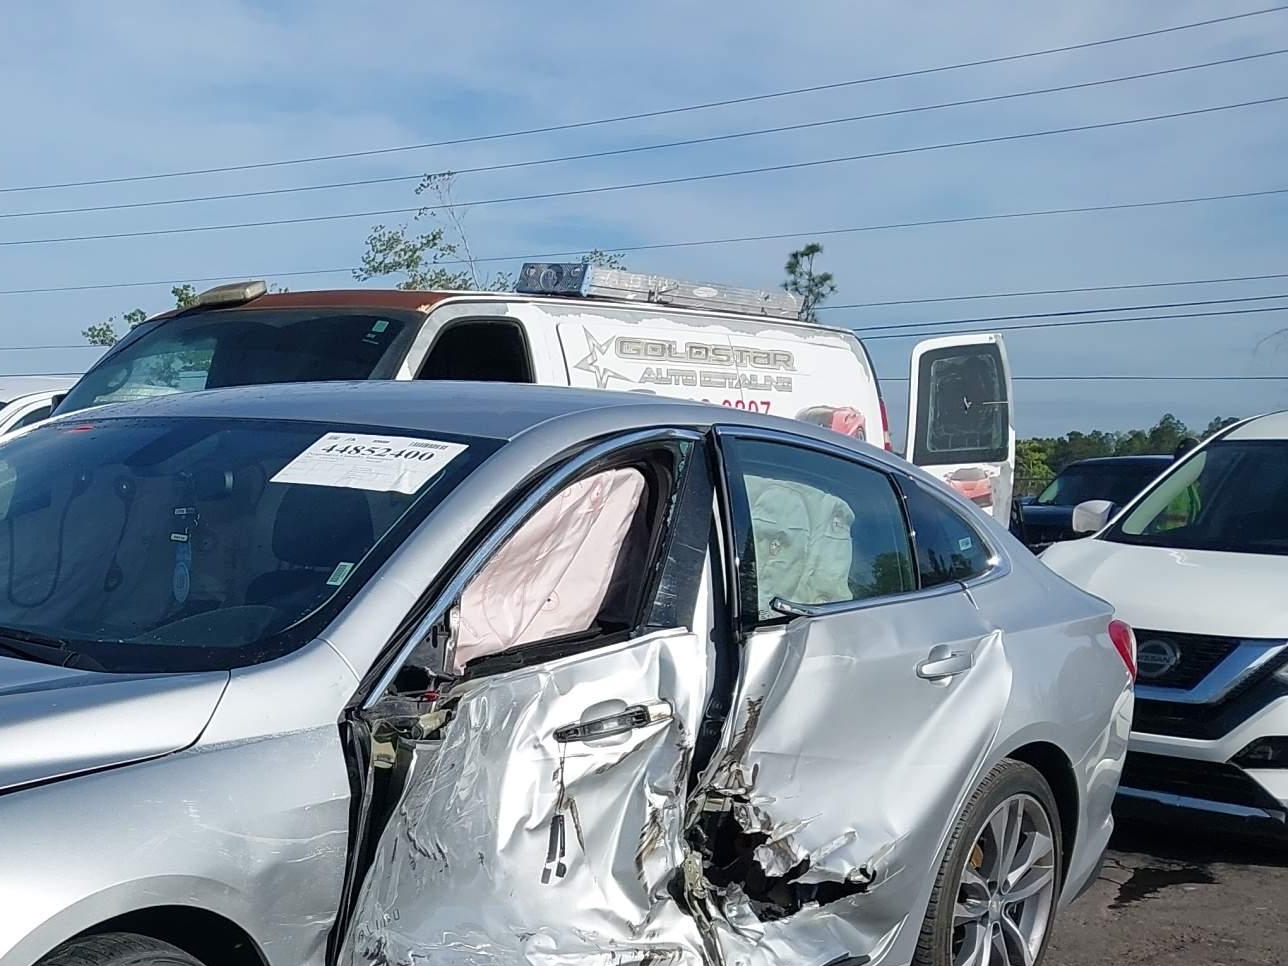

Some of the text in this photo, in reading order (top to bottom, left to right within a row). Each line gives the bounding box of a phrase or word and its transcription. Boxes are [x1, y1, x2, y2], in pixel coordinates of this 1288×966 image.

[615, 336, 797, 371] GOLDSTAR
[638, 366, 697, 386] AUTO
[321, 443, 435, 462] 44852400
